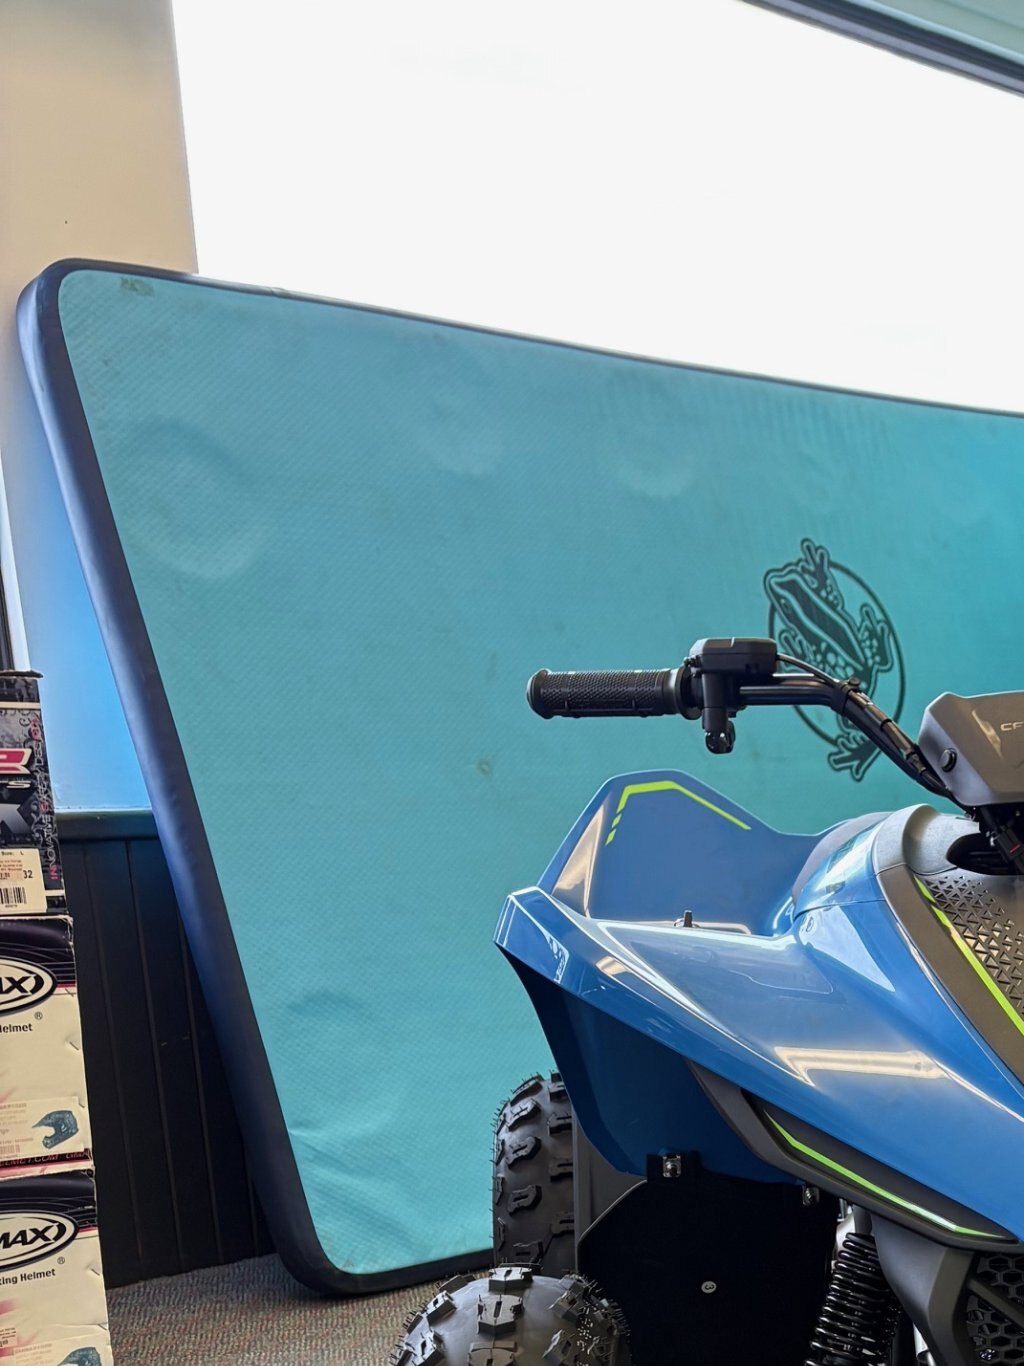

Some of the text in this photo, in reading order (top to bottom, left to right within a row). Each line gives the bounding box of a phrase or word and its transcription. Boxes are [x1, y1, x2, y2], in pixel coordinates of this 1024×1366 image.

[23, 869, 34, 879] 32
[0, 1268, 56, 1286] ing Helmet
